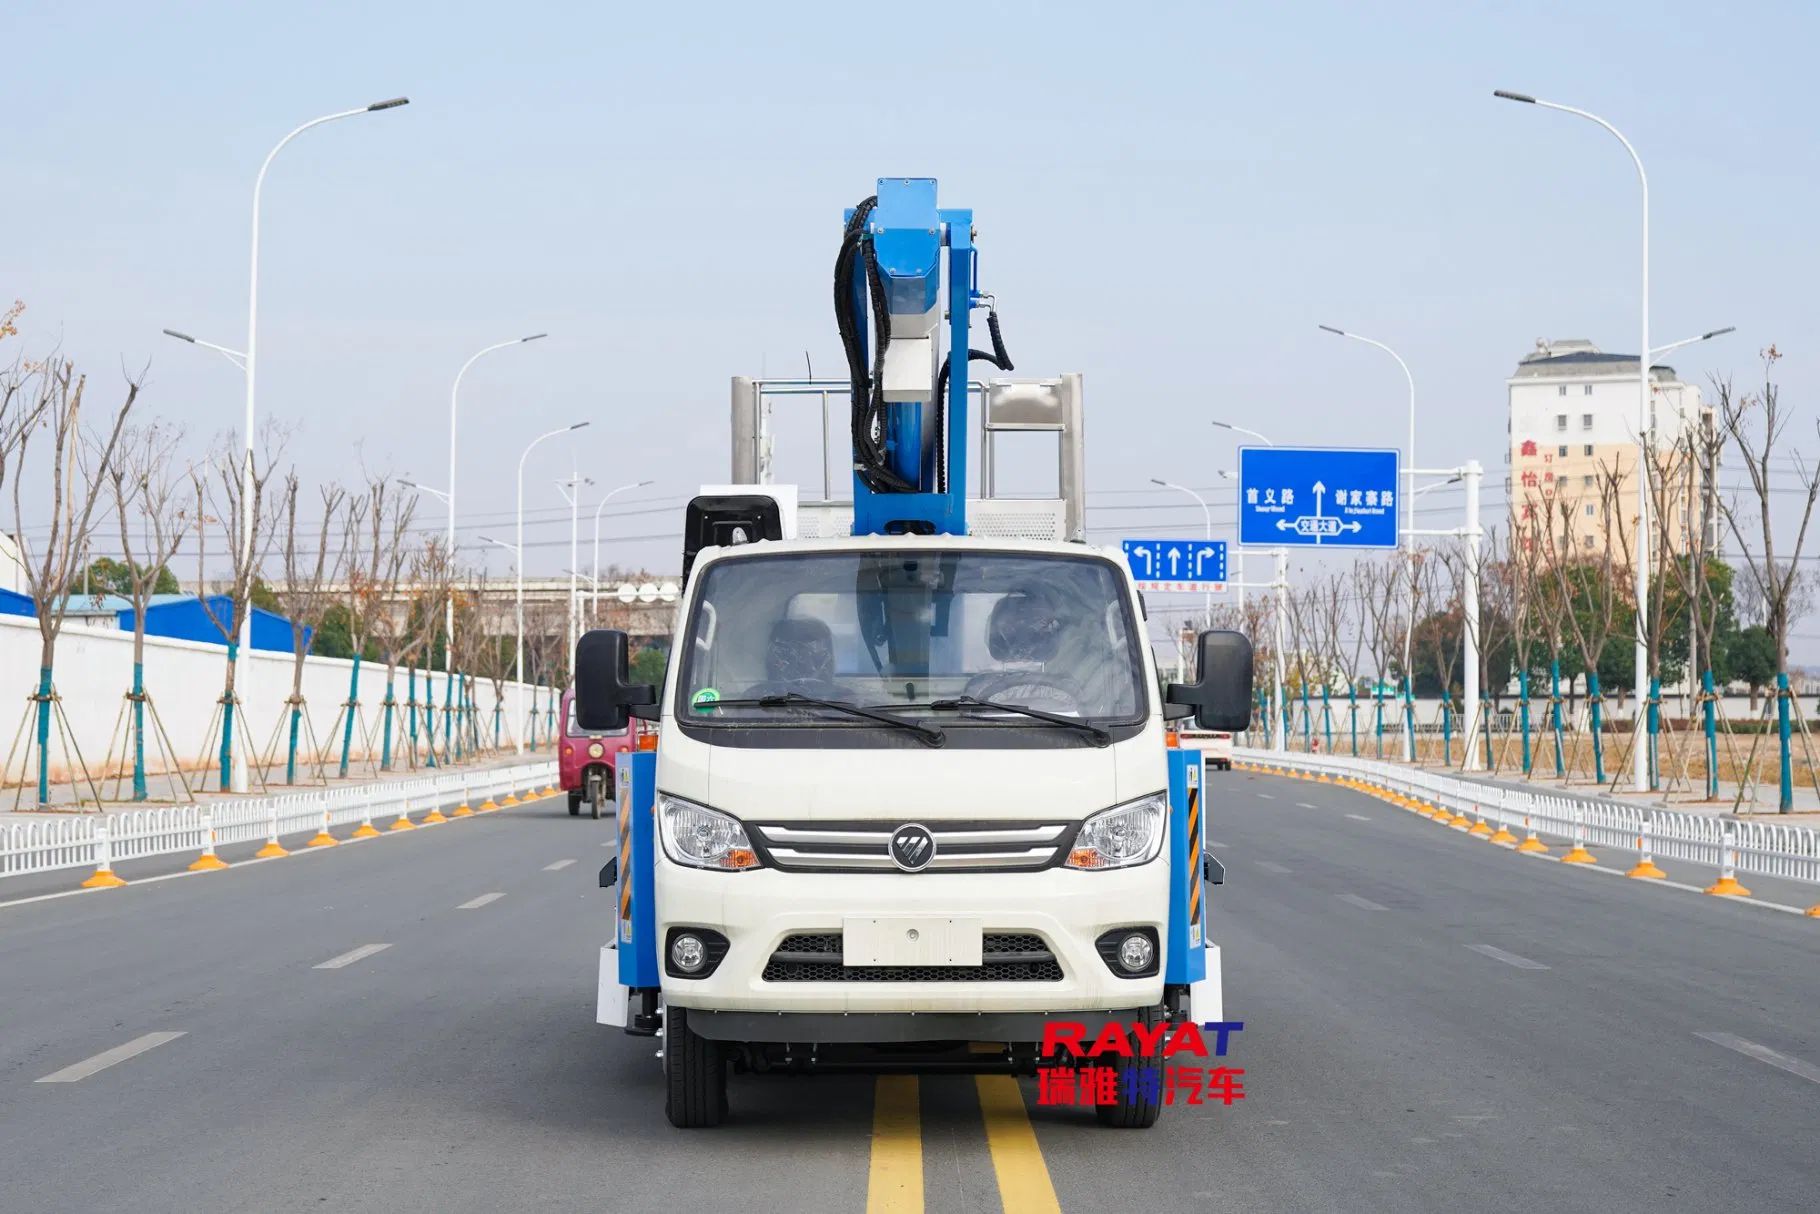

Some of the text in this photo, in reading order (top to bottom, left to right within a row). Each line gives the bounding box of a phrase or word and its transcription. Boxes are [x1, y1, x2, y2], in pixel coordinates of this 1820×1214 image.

[1246, 488, 1294, 505] 首义路
[1300, 520, 1337, 533] 交通大道
